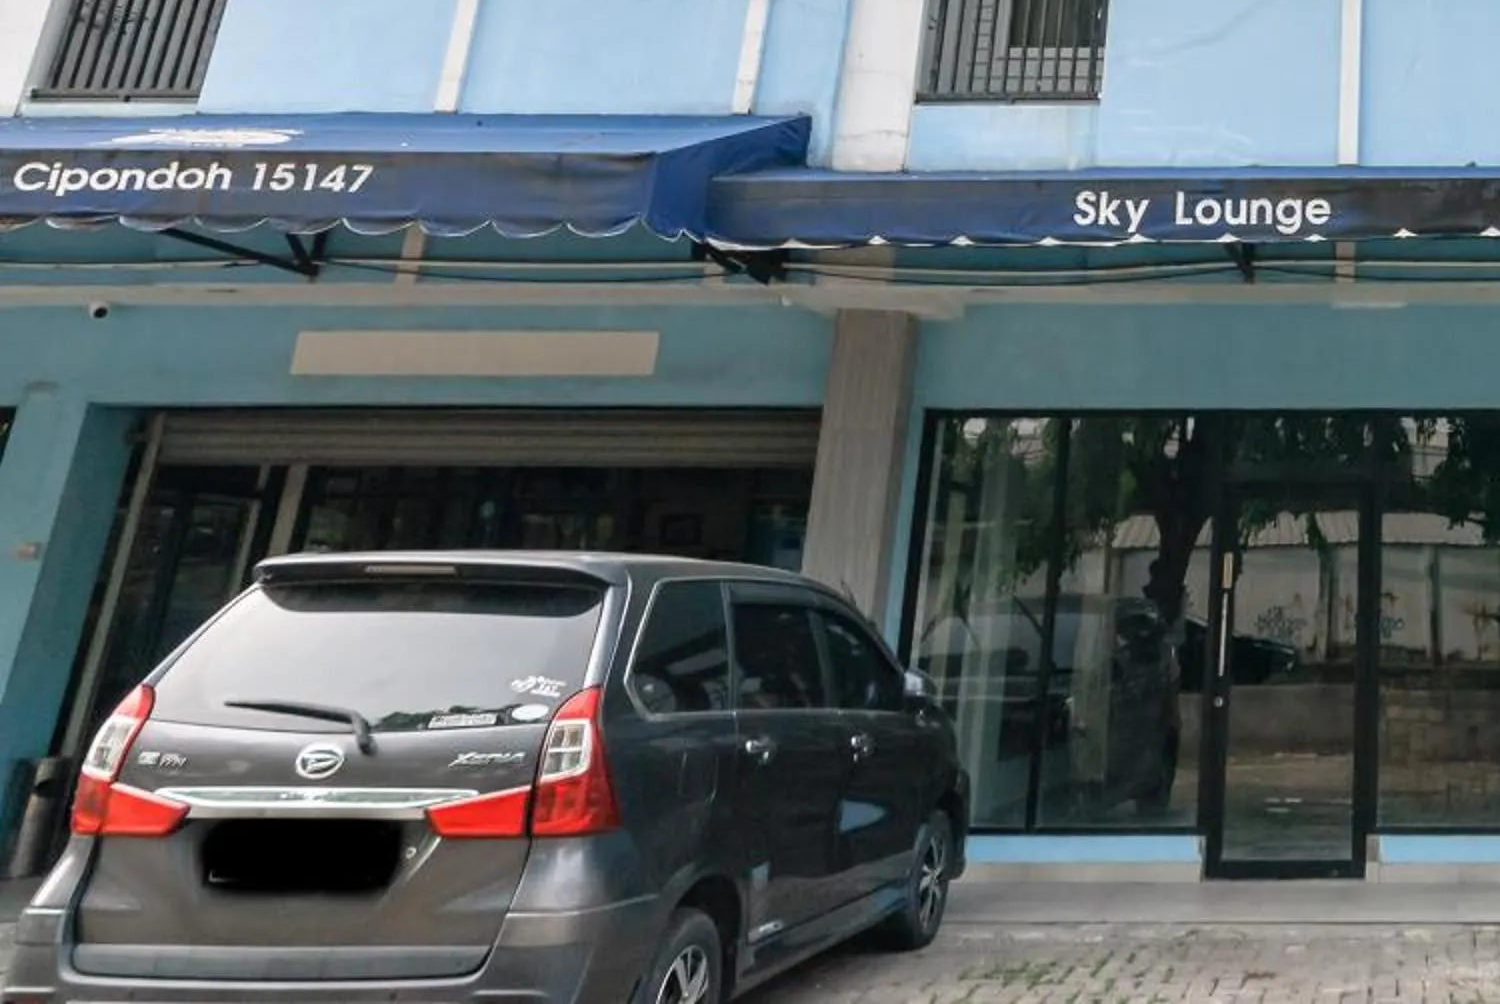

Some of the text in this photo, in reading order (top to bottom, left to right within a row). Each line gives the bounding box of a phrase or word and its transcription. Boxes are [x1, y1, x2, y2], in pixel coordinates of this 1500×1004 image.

[13, 161, 374, 197] Cipondoh 15147
[1073, 190, 1332, 235] Sky Lounge
